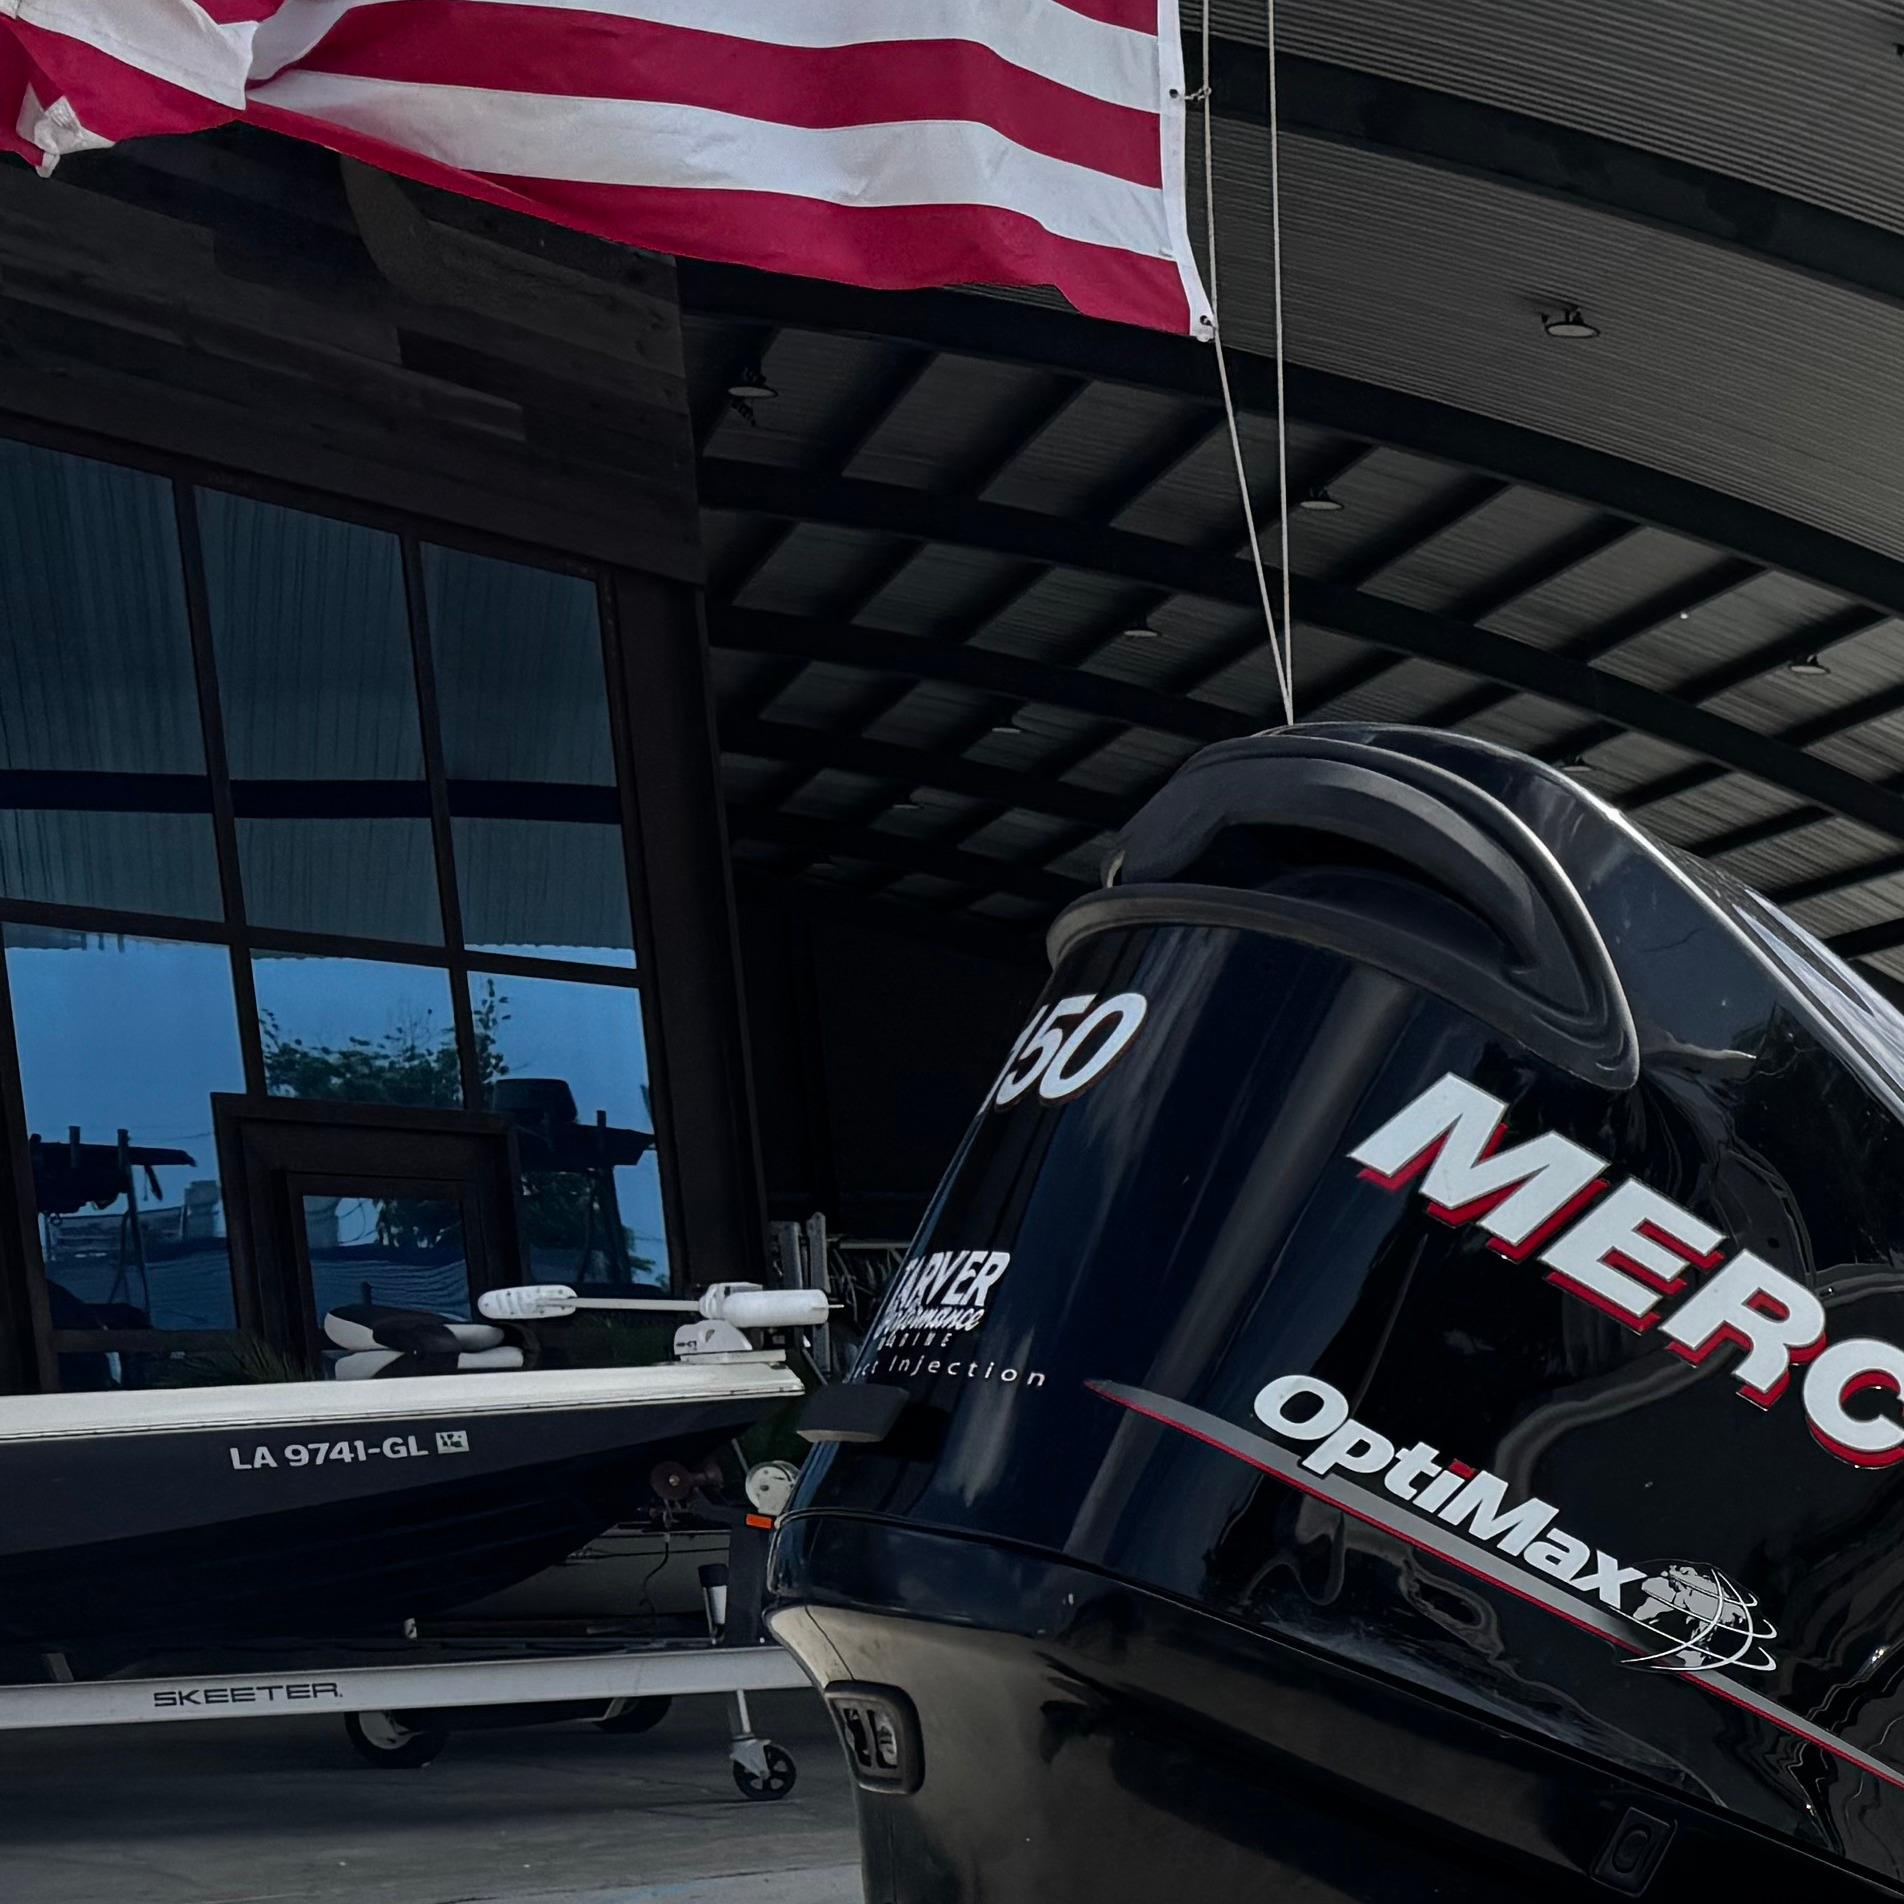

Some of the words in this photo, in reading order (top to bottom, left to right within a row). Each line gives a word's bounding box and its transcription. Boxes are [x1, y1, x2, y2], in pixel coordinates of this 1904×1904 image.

[888, 1354, 1046, 1388] Injection
[229, 1448, 278, 1470] LA
[284, 1435, 429, 1467] 9741-GL
[1253, 1374, 1645, 1612] OptiMax
[153, 1682, 339, 1707] SKEETER
